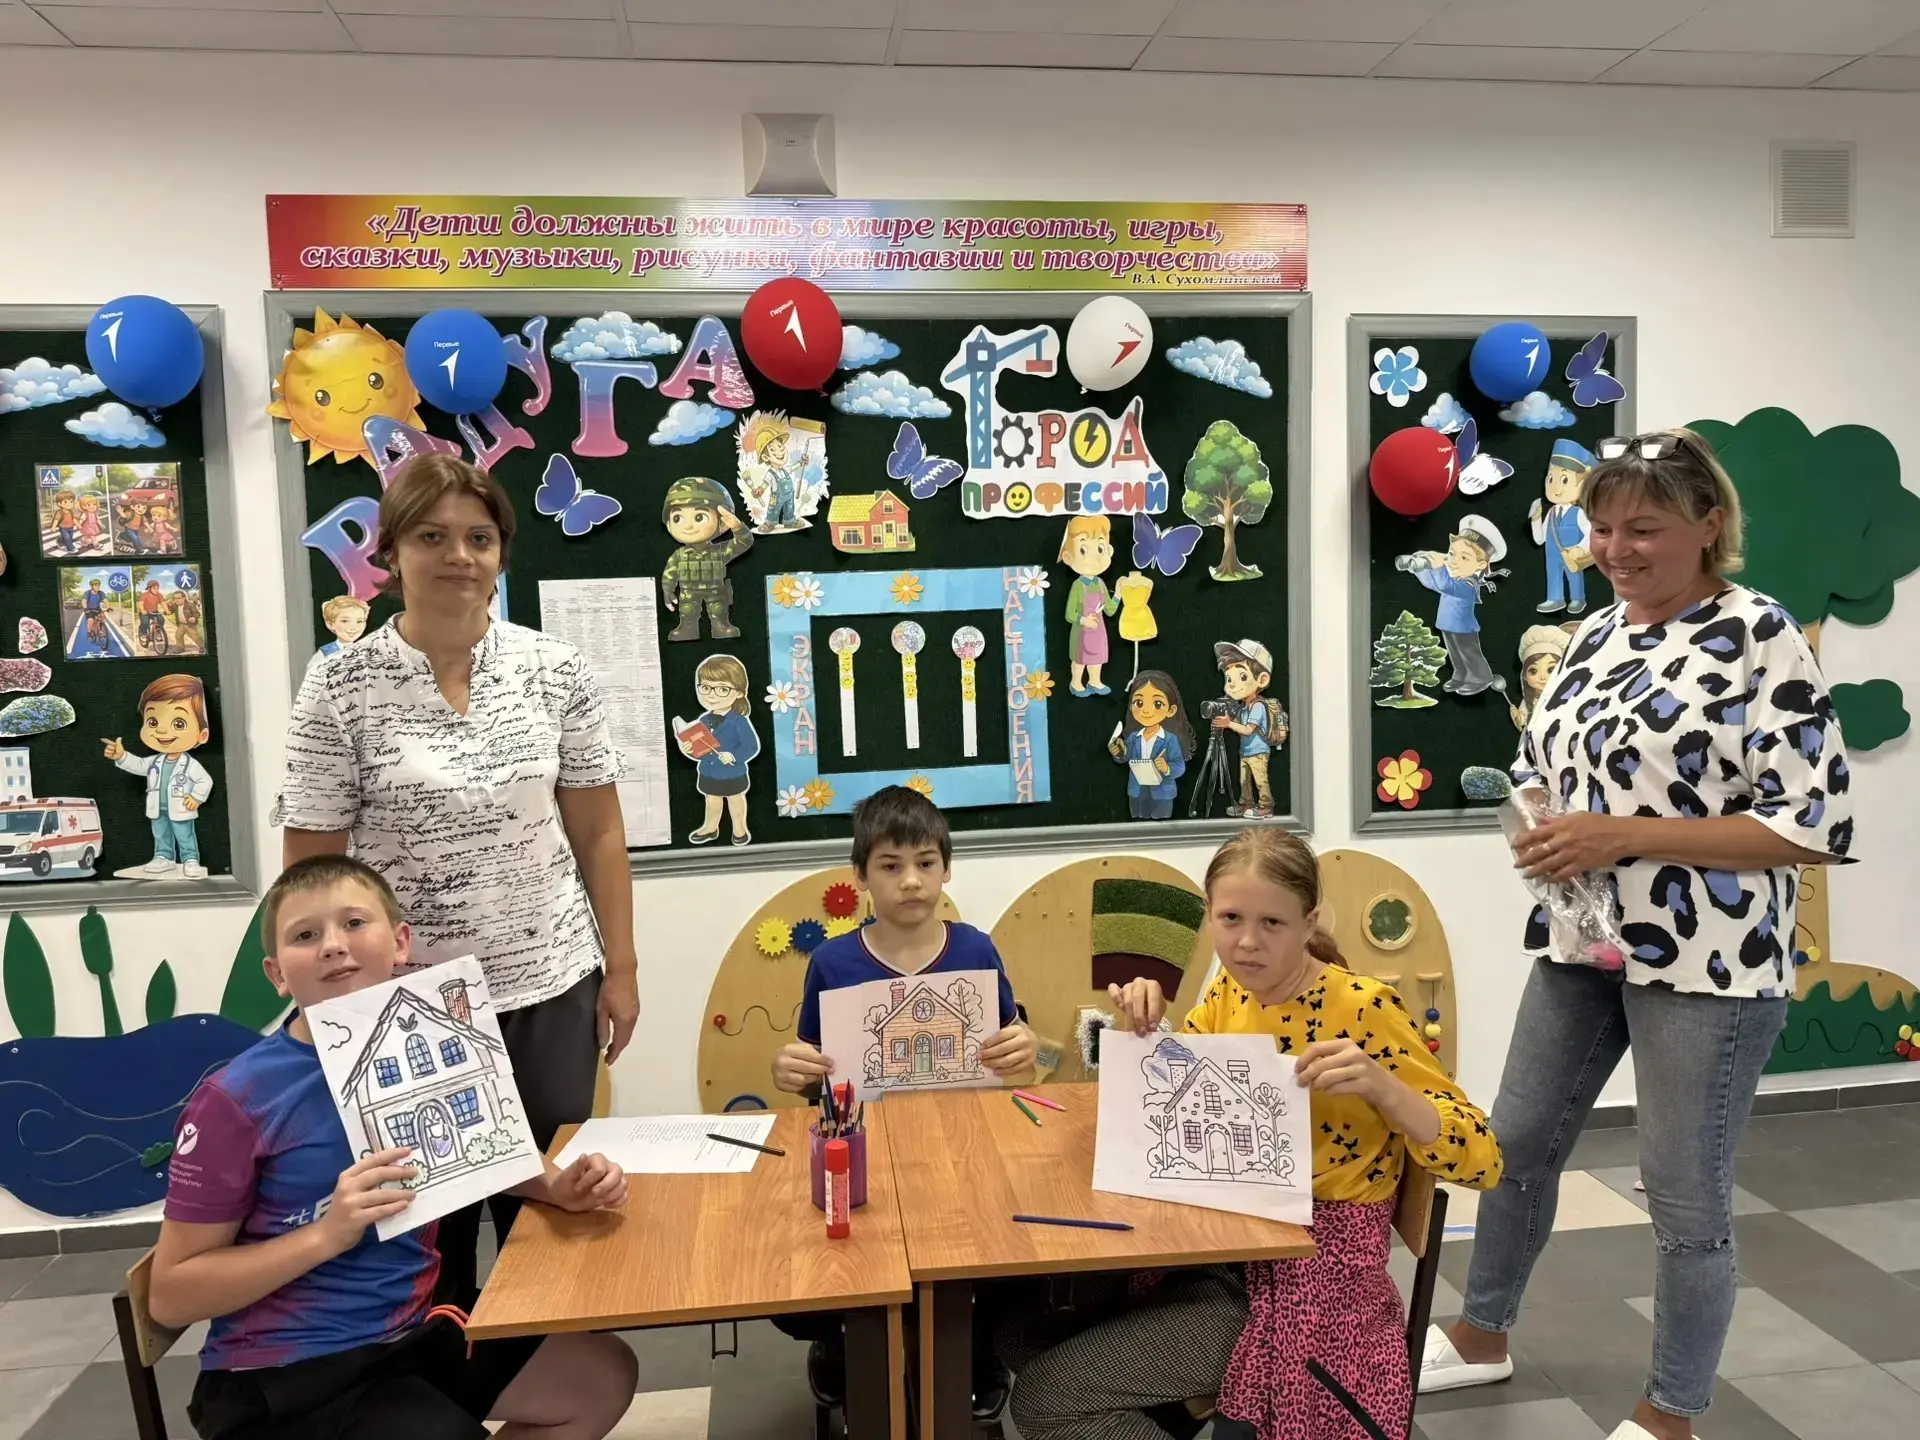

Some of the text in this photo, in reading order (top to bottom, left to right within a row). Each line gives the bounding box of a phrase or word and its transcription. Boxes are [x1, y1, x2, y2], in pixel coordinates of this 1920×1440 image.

[366, 205, 1223, 246] «Дети должны жить в мире красоты, игры,
[300, 245, 450, 273] сказки,
[460, 246, 621, 276] музыки,
[809, 241, 1004, 278] фантазии
[1011, 250, 1033, 269] и
[1042, 248, 1280, 277] творчества»
[1132, 273, 1281, 286] В.А. Сухомлинский
[944, 328, 1149, 469] ГОРОД
[963, 471, 1167, 513] ПРОФЕССИЙ
[792, 635, 815, 755] ЭКРАН
[1003, 567, 1034, 803] НАСТРОЕНИЯ
